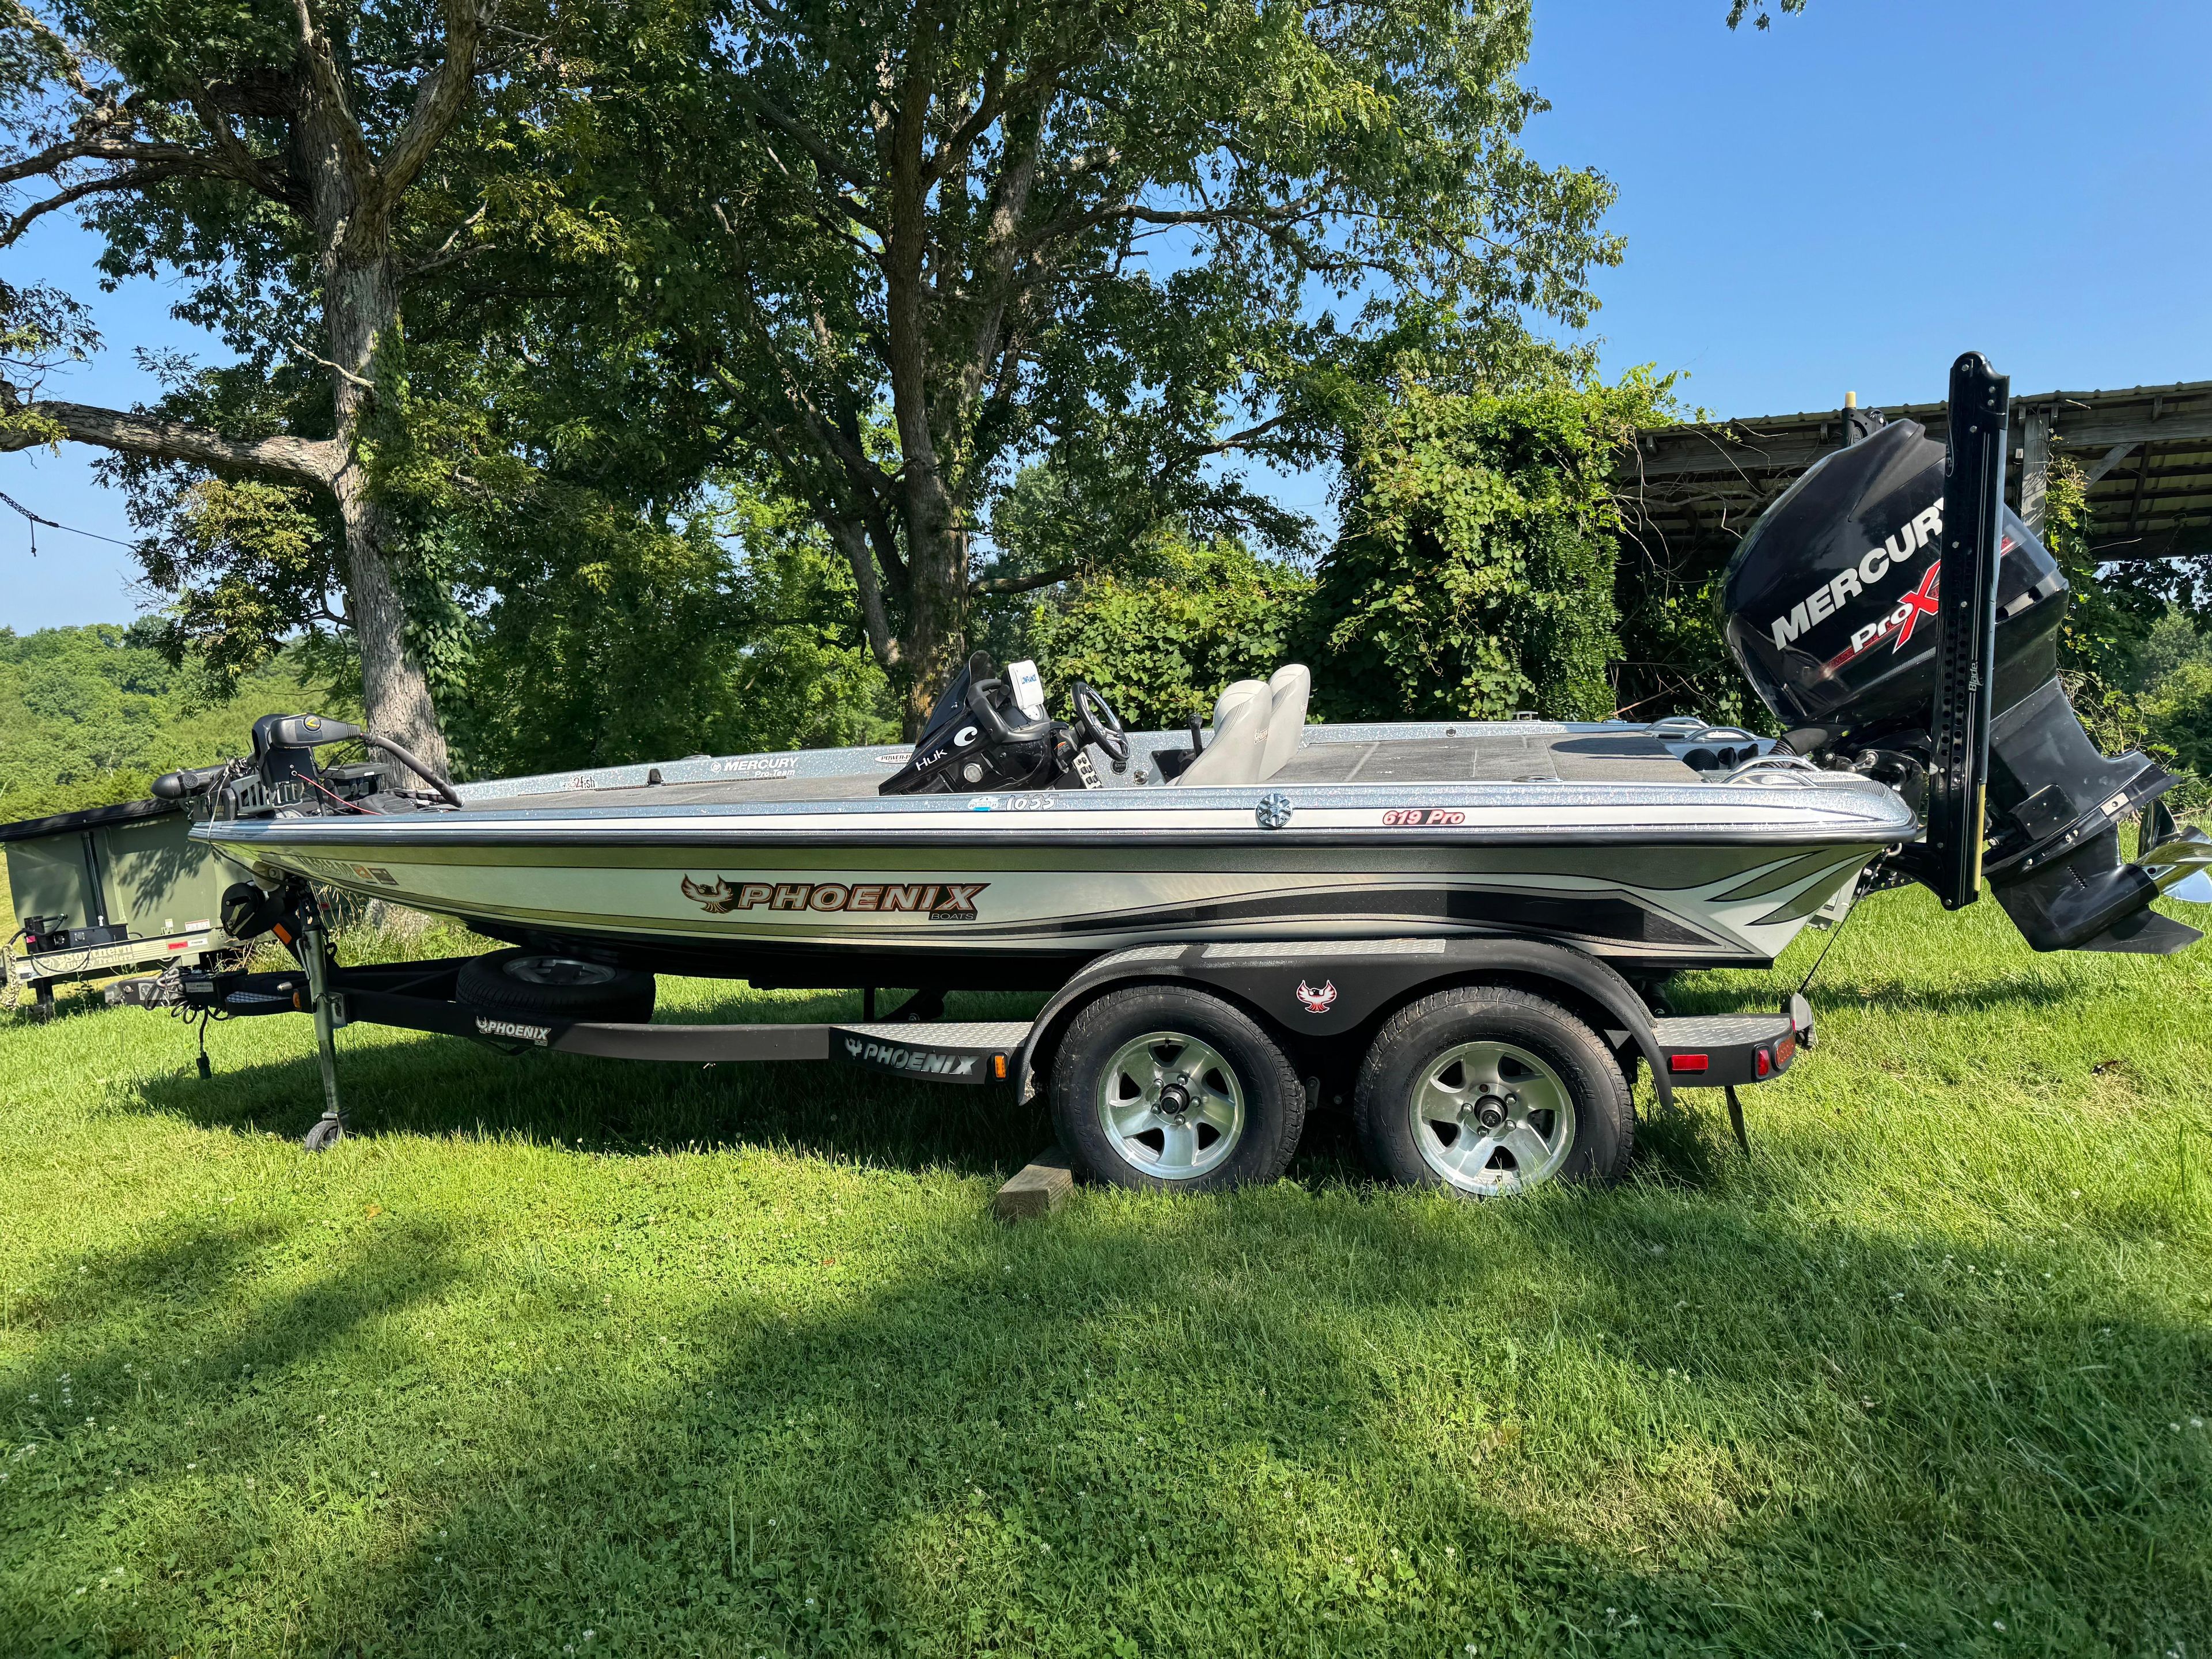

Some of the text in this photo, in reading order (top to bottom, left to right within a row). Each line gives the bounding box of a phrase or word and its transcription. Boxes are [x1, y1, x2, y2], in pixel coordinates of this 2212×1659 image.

[1771, 497, 1944, 651] MERCUR
[724, 757, 799, 771] MERCURY
[1383, 809, 1465, 825] 619 Pro
[738, 885, 986, 911] PHOENIX
[931, 912, 974, 921] BOATS
[96, 953, 134, 965] Trailers
[488, 1020, 551, 1040] PHOENIX
[864, 1043, 980, 1075] PHOENIX
